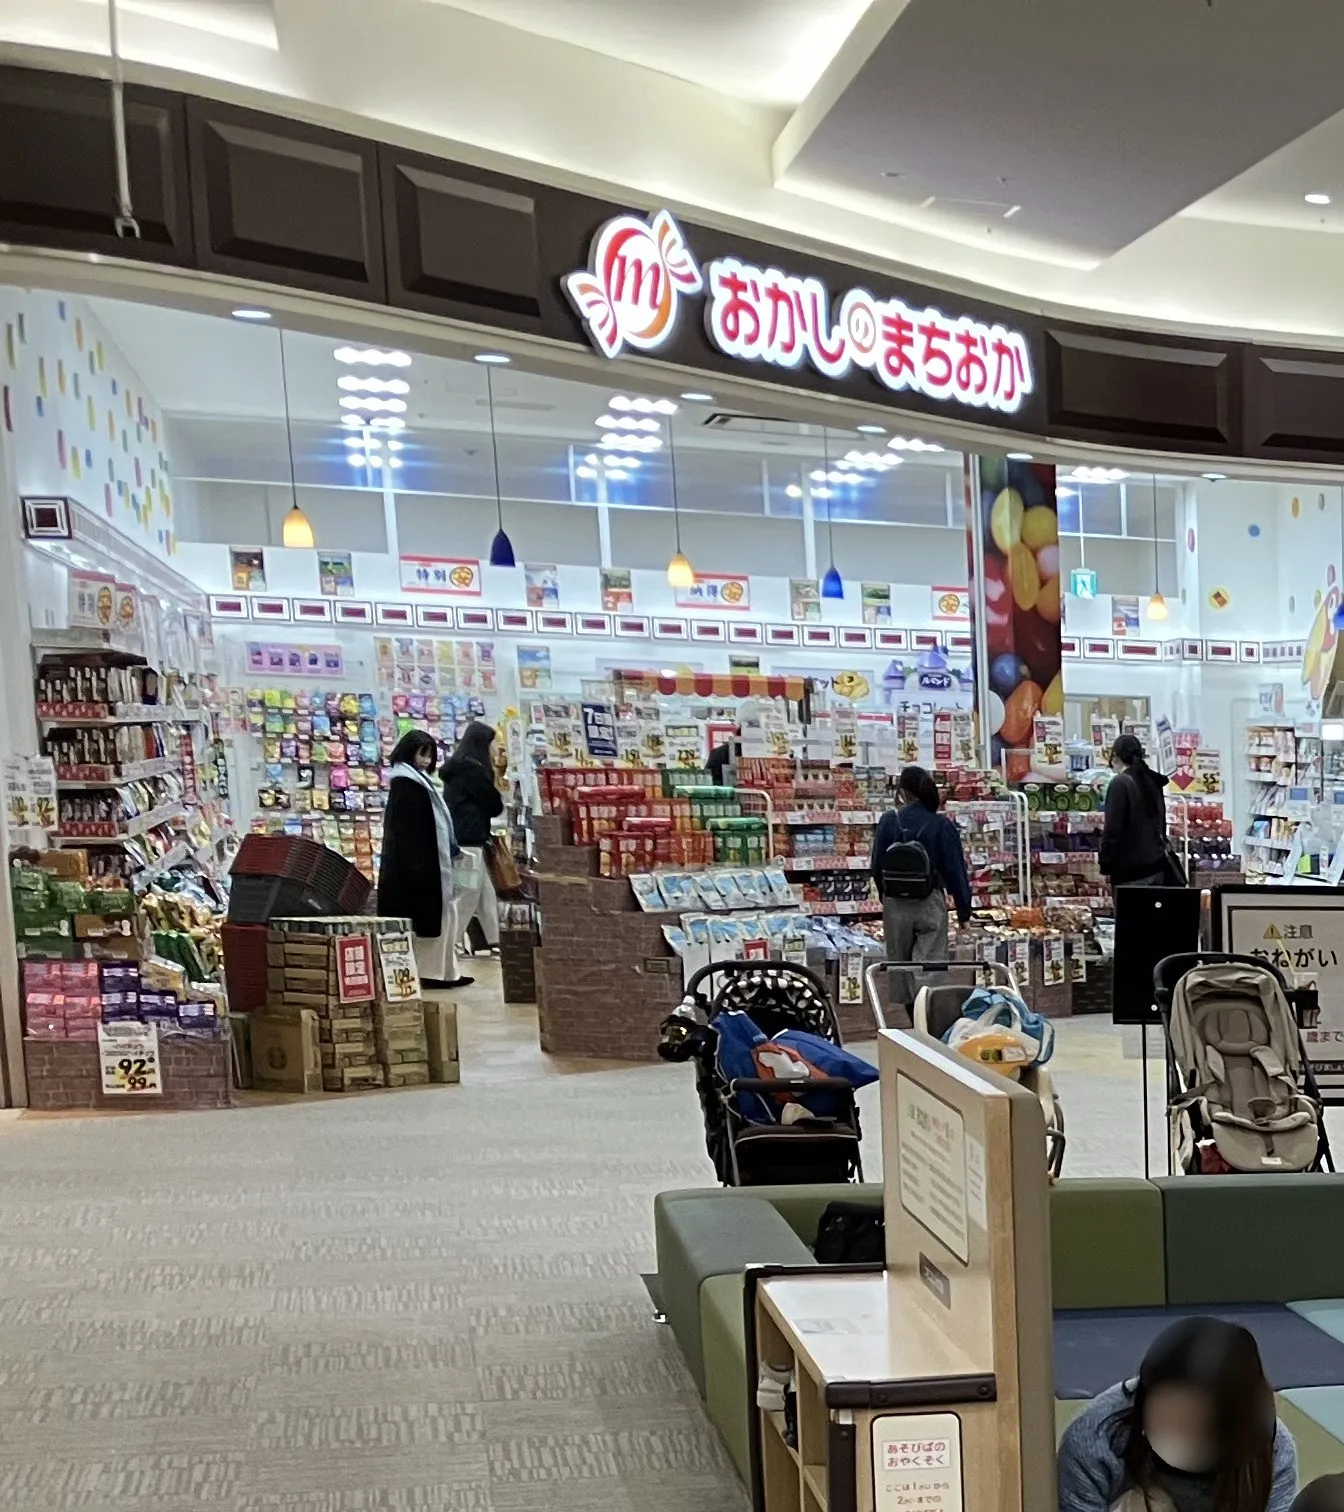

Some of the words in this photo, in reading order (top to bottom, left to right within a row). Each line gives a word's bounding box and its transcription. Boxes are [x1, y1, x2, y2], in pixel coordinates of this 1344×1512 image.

[717, 268, 1027, 404] おかしのまちおか
[118, 1058, 147, 1076] 92
[887, 1442, 946, 1455] あそびばの
[887, 1455, 945, 1468] おやくそく
